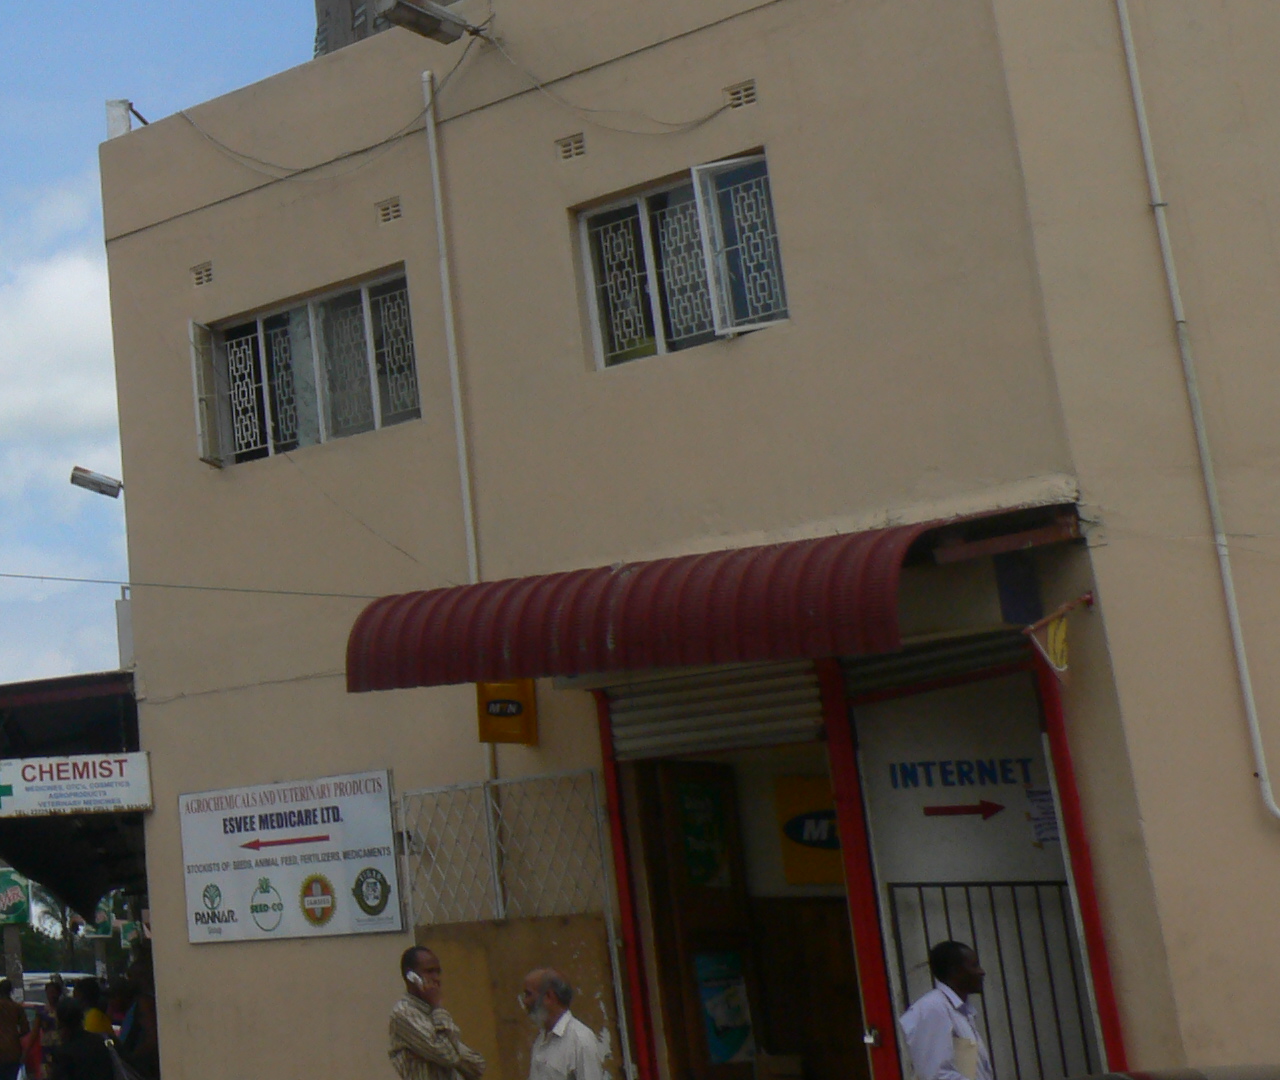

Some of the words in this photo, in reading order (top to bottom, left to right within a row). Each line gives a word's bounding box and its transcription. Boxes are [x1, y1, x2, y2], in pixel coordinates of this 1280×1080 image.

[487, 703, 519, 714] MTN
[21, 758, 128, 782] CHEMIST
[889, 757, 1034, 790] INTERNET
[184, 795, 257, 815] AGROCHEMICALS
[258, 791, 276, 808] AND
[276, 784, 332, 804] VETERINARY
[333, 777, 383, 798] PRODUCTS
[222, 814, 256, 835] ESVEE
[257, 807, 318, 831] MEDICARE
[320, 805, 344, 825] LTD.
[254, 857, 278, 869] ANIMAL
[194, 909, 236, 925] PANNAR
